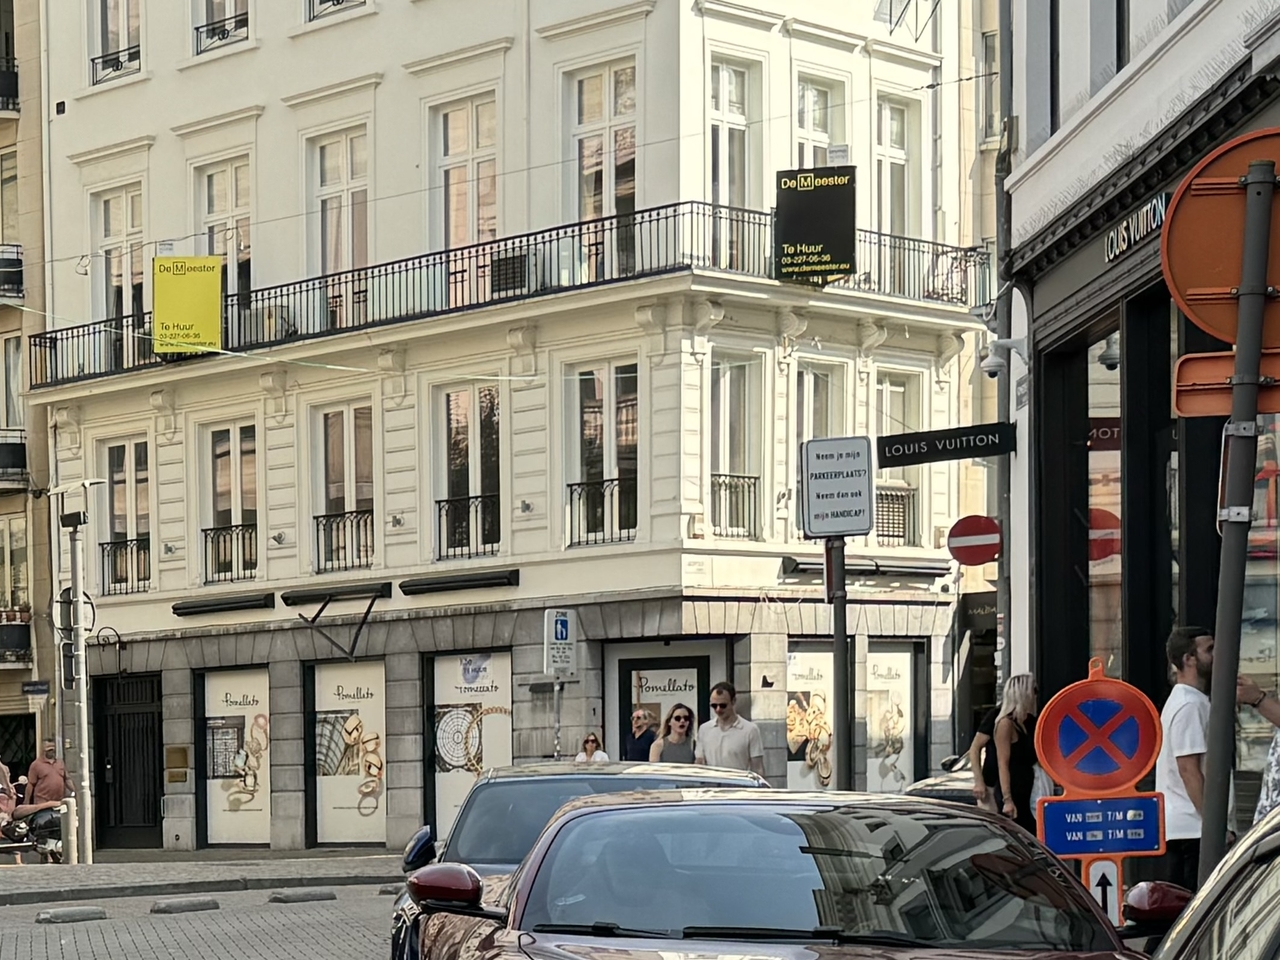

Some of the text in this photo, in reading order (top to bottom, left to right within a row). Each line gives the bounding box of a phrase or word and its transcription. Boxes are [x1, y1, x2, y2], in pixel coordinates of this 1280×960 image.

[1105, 192, 1166, 263] LOUIS VUITTON
[782, 243, 824, 254] Te Huur
[160, 322, 195, 331] Te Huur
[885, 433, 1000, 457] LOUIS VUITTON
[815, 451, 860, 461] Neem je mijn
[810, 469, 867, 480] PARKEERPLAATS?
[815, 489, 862, 500] Neem dan ook
[814, 509, 865, 521] mijn HANDICAP!
[633, 677, 695, 693] Pomellato
[333, 685, 374, 700] Pomellato
[222, 692, 259, 707] Pomellato
[1065, 813, 1083, 823] VAN
[1107, 811, 1124, 821] T/M
[1066, 831, 1083, 841] VAN
[1108, 829, 1124, 839] T/M
